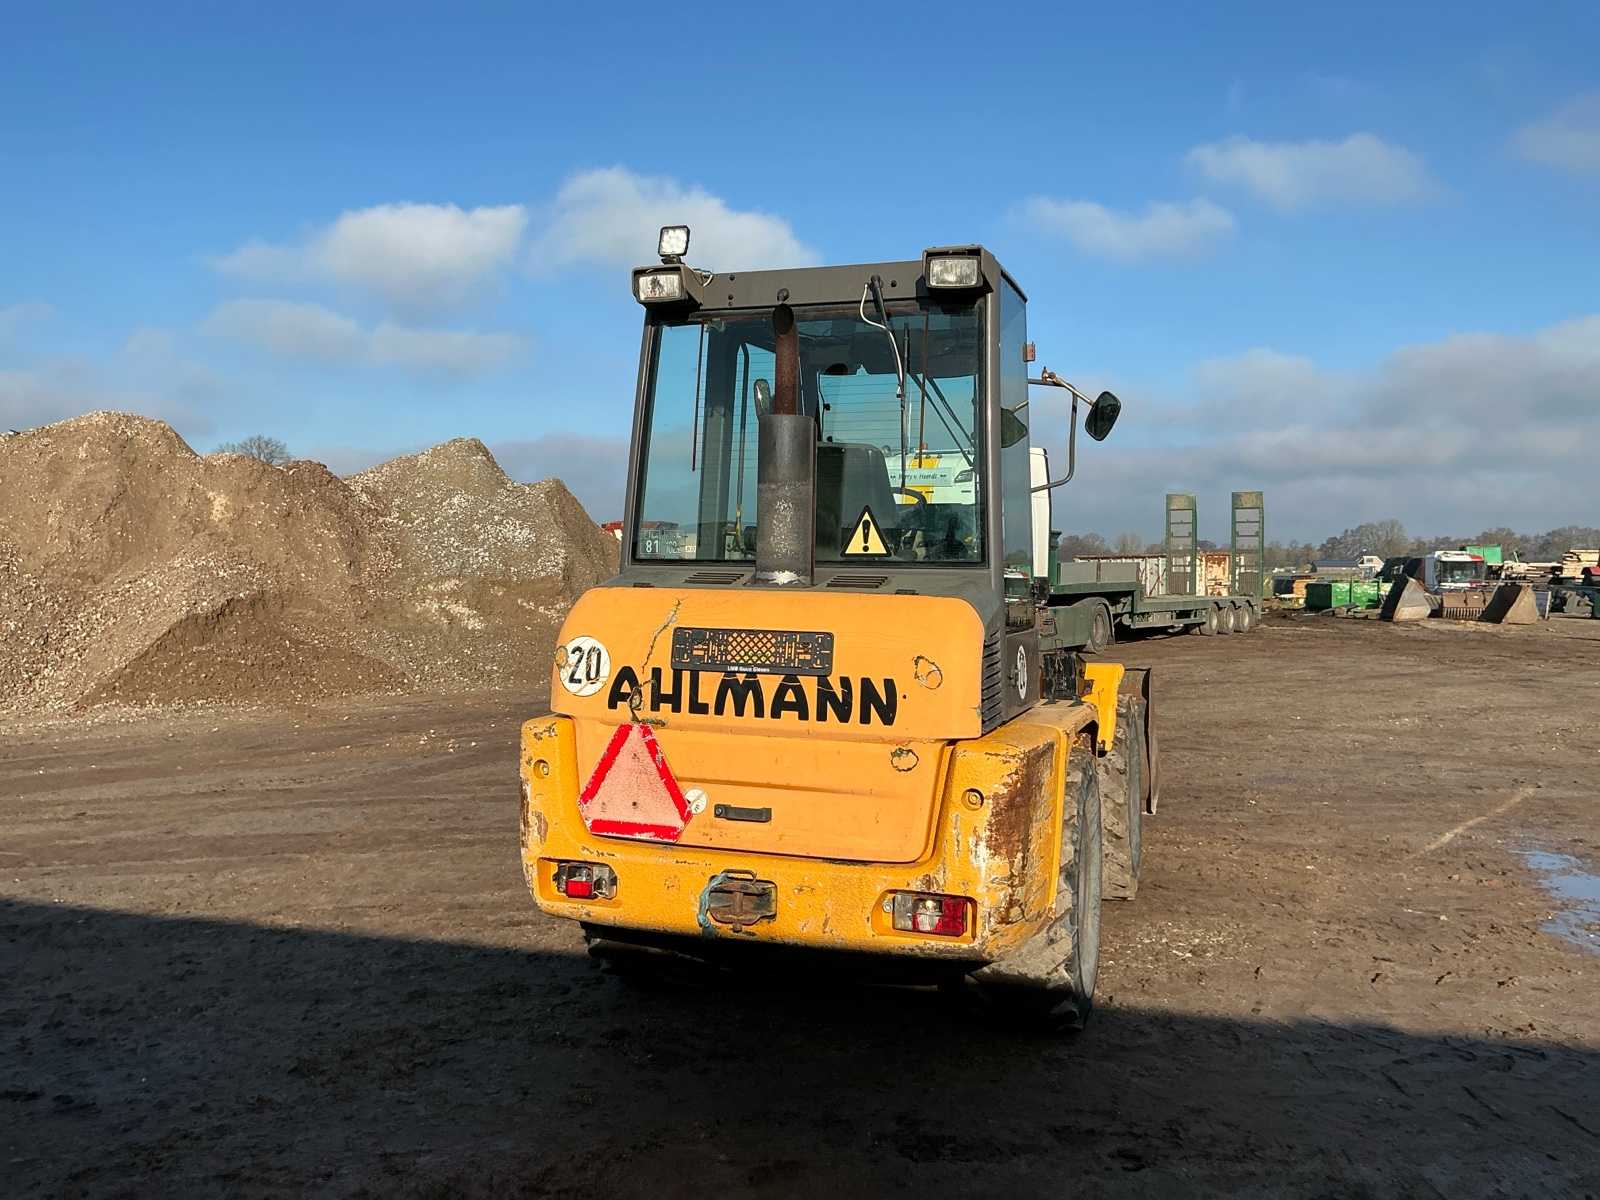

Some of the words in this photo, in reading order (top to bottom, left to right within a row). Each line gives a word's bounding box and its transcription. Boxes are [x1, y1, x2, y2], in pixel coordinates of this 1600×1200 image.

[645, 539, 660, 553] 81
[568, 645, 602, 684] 20
[607, 665, 898, 726] AHLMANN
